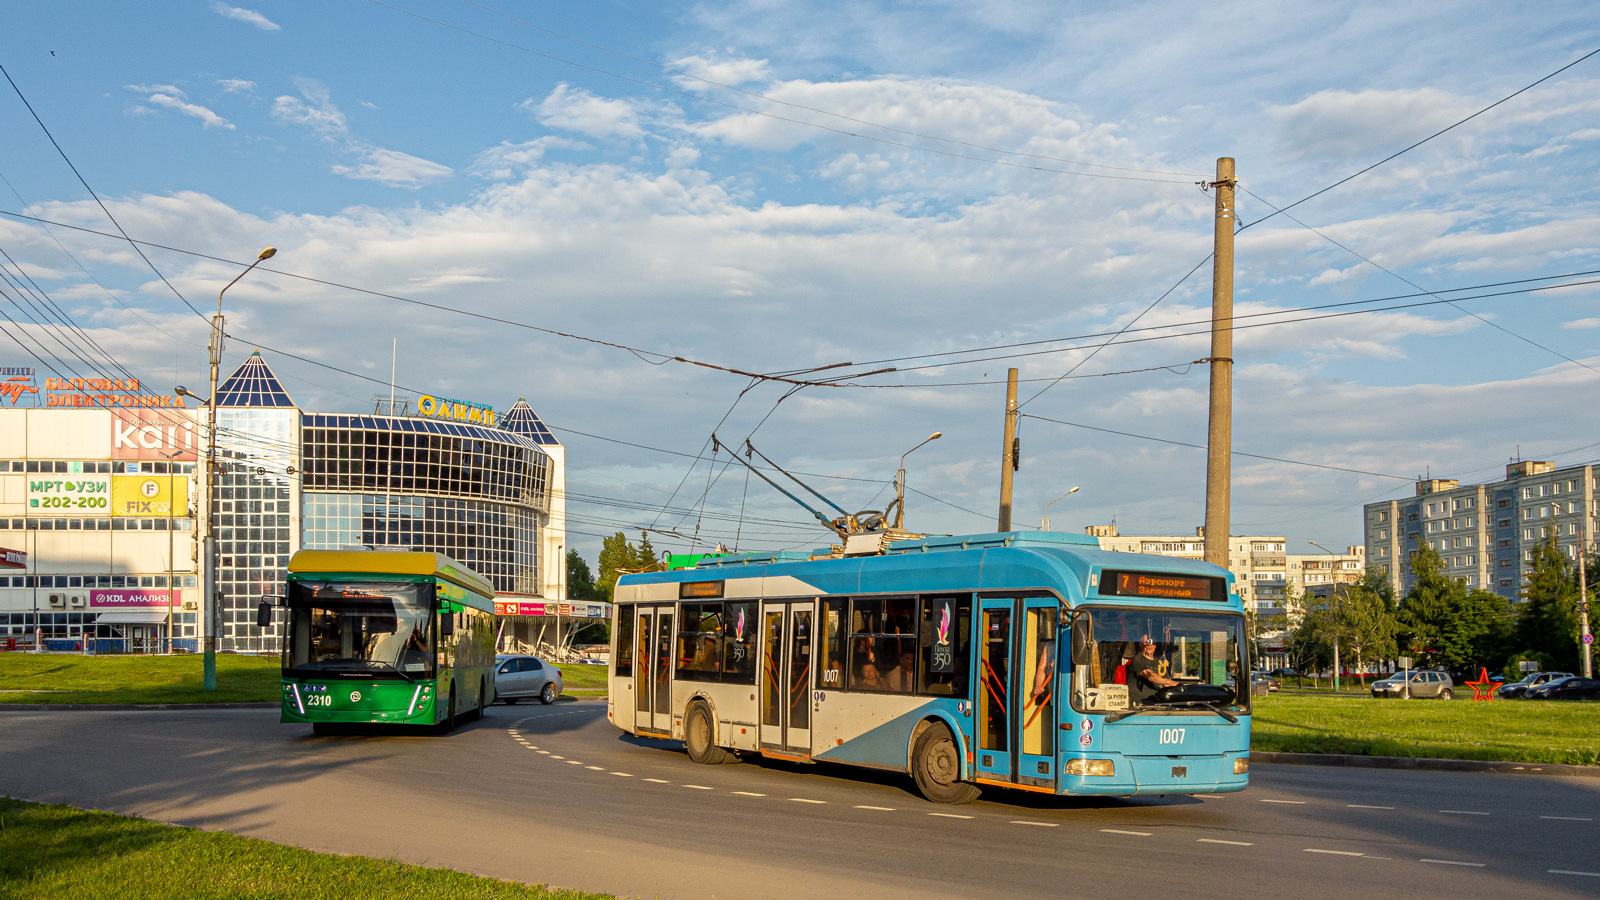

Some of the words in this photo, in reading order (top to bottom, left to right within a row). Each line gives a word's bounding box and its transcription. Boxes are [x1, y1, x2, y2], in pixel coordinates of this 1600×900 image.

[46, 377, 139, 391] БЫТОВАЯ
[46, 394, 186, 408] ЭЛЕКТРОНИКА
[115, 418, 193, 449] kari
[30, 481, 63, 492] МРТ
[76, 481, 107, 493] УЗИ
[42, 496, 107, 508] 202-200
[1122, 575, 1129, 588] 7
[1138, 576, 1185, 587] Аэропорт
[733, 648, 745, 662] 350
[934, 645, 950, 653] Пенза
[933, 653, 951, 670] 350
[824, 670, 839, 682] 1007
[307, 695, 332, 706] 2310
[1088, 692, 1098, 707] 7
[1159, 728, 1186, 744] 1007
